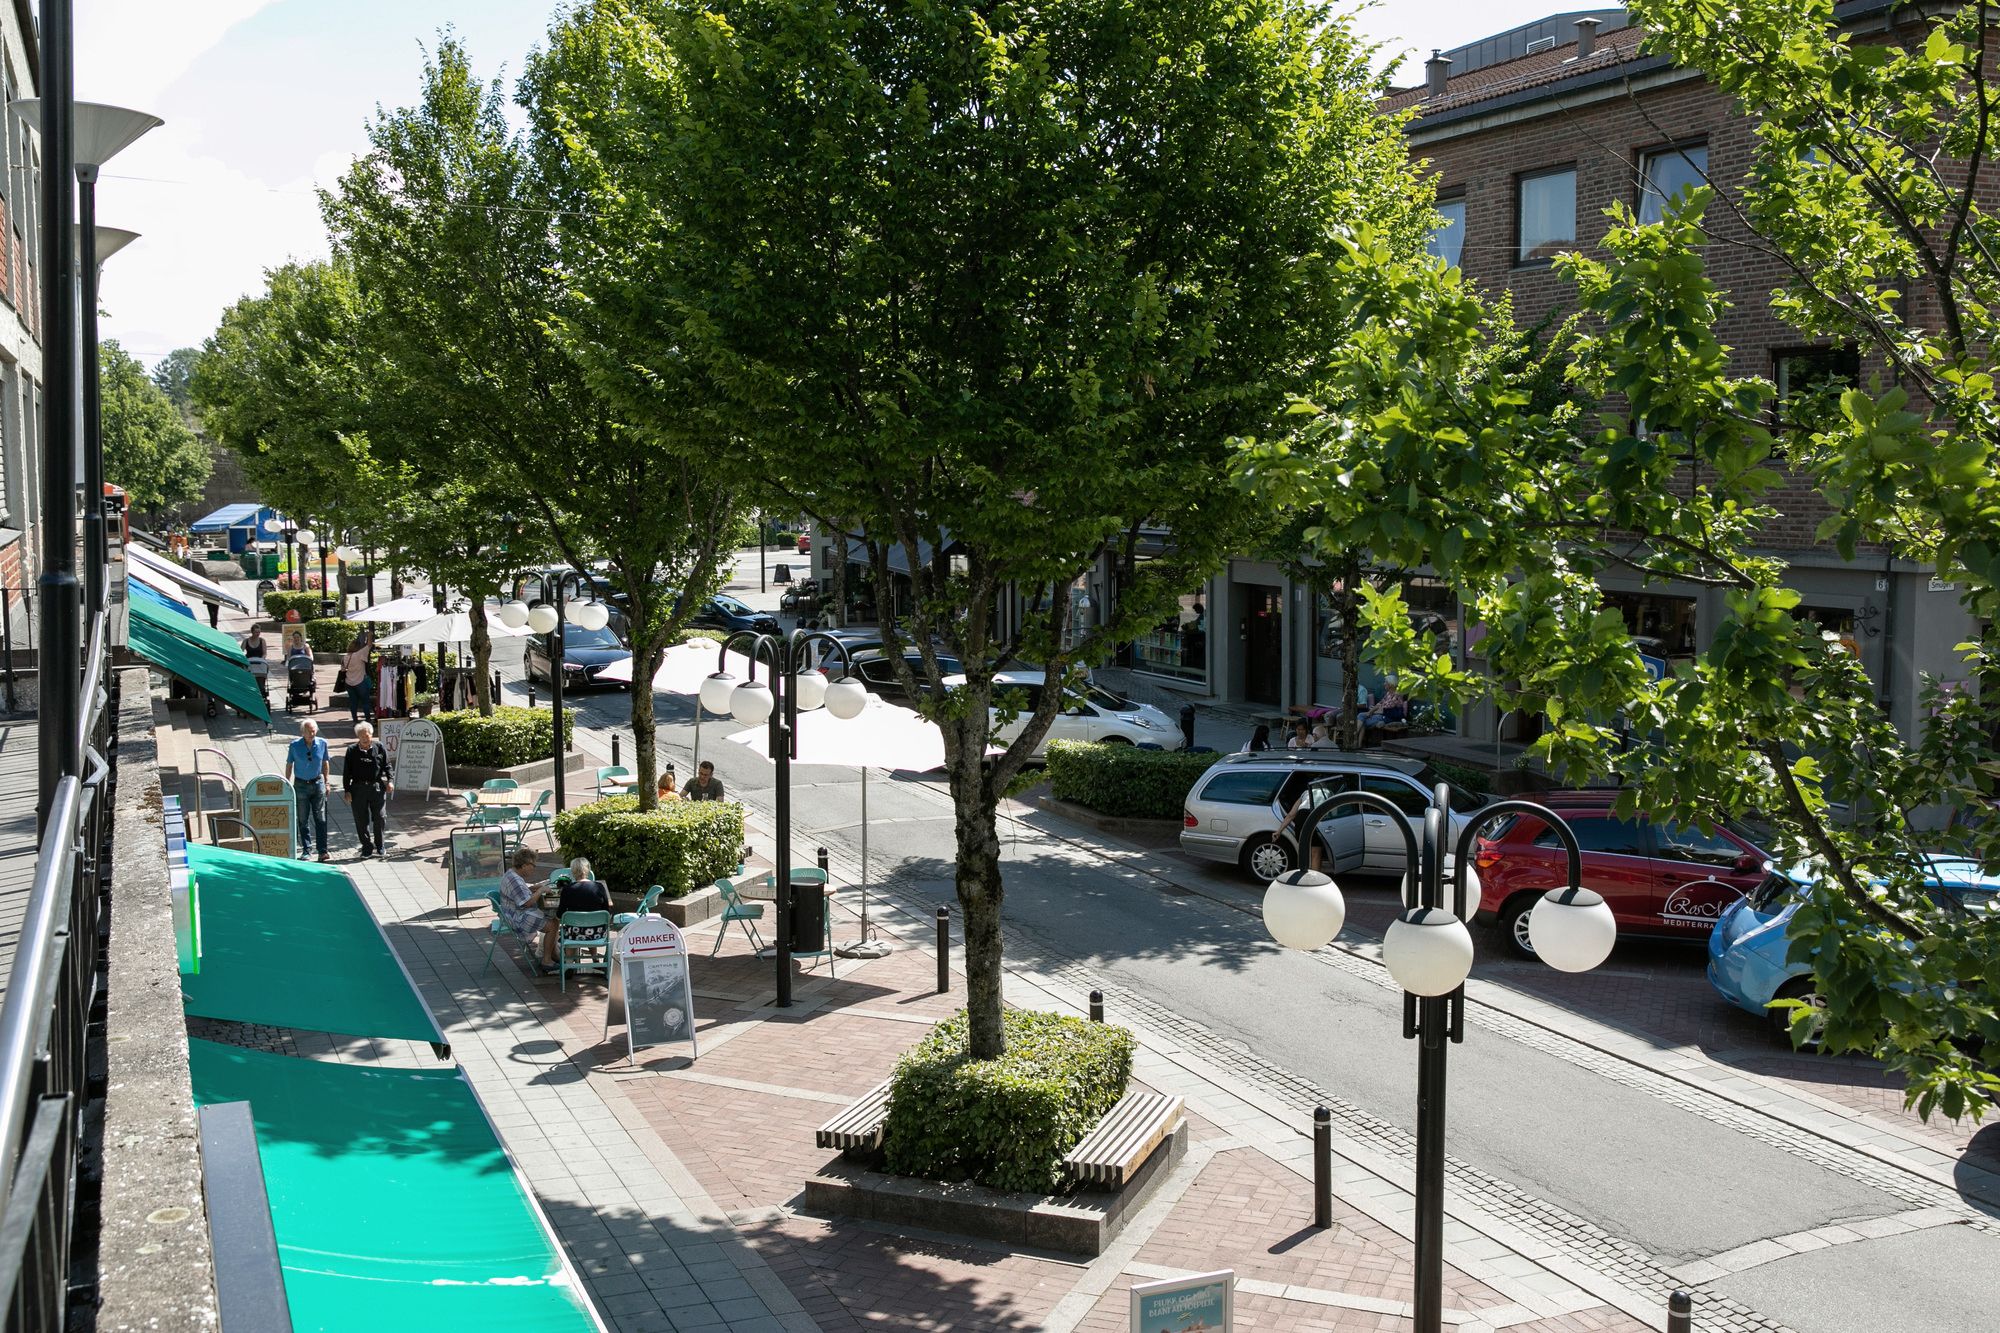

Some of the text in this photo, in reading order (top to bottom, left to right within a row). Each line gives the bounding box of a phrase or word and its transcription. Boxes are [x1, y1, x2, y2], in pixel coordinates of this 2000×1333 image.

[254, 807, 287, 818] PIZZA
[628, 933, 676, 946] URMAKER
[1178, 1294, 1192, 1303] OG
